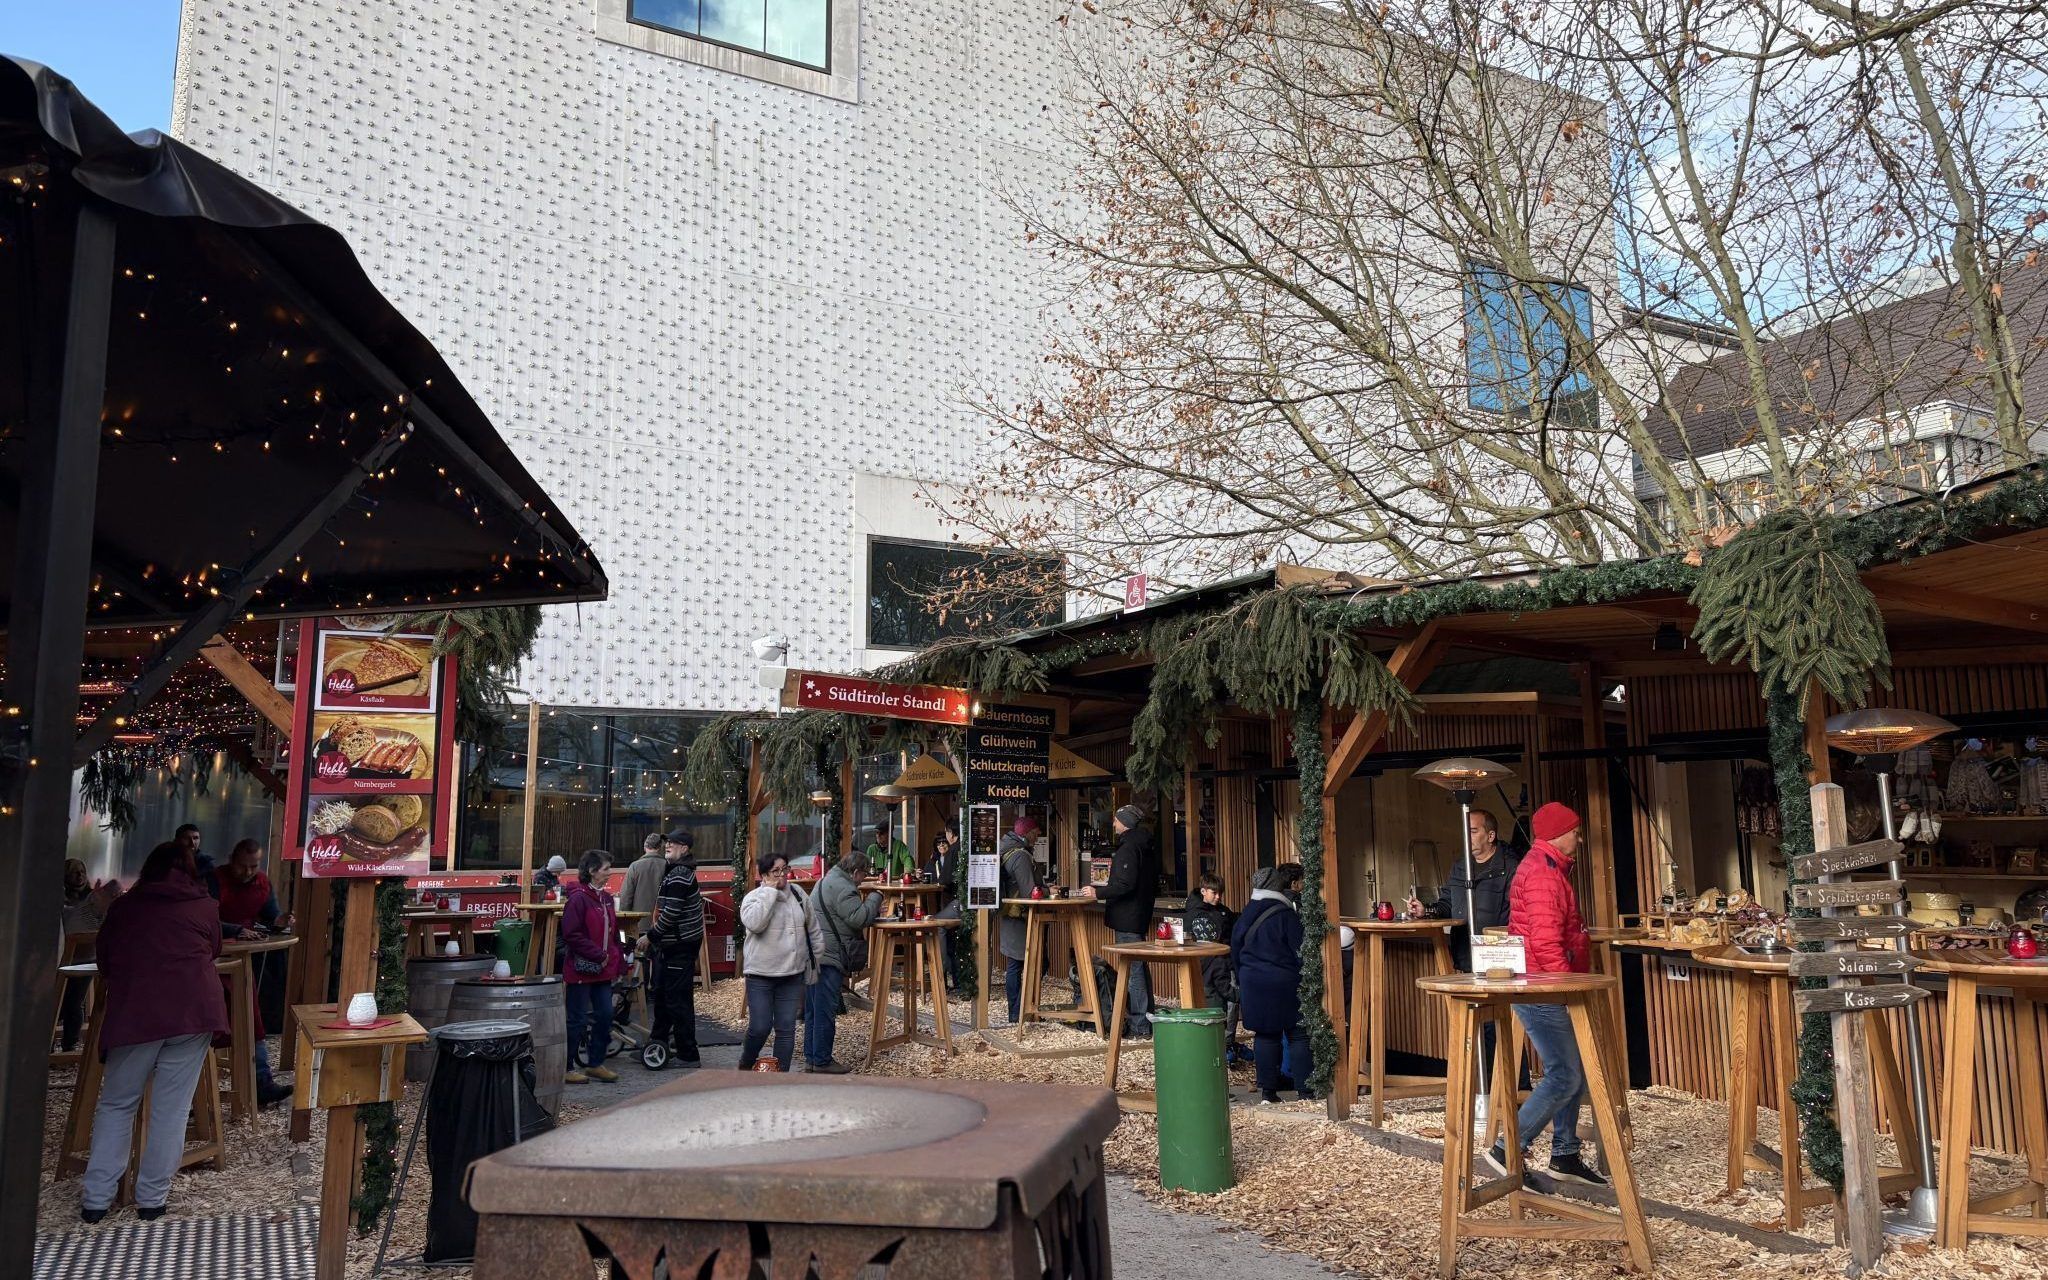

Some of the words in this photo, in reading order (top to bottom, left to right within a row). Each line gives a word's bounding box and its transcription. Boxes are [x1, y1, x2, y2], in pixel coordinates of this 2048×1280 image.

[328, 678, 355, 690] Hehle
[828, 686, 900, 708] Südtiroler
[903, 694, 947, 712] Standl
[979, 706, 1051, 725] Bauerntoast
[980, 734, 1037, 749] Glühwein
[318, 761, 349, 775] Hehle
[970, 758, 1046, 775] Schlutzkrapfen
[353, 780, 396, 790] Nürnbergerle
[987, 784, 1030, 798] Knödel
[311, 844, 342, 858] Hehle
[466, 902, 518, 913] BREGENZ
[1839, 957, 1878, 972] Salami
[1845, 991, 1876, 1007] Käse
